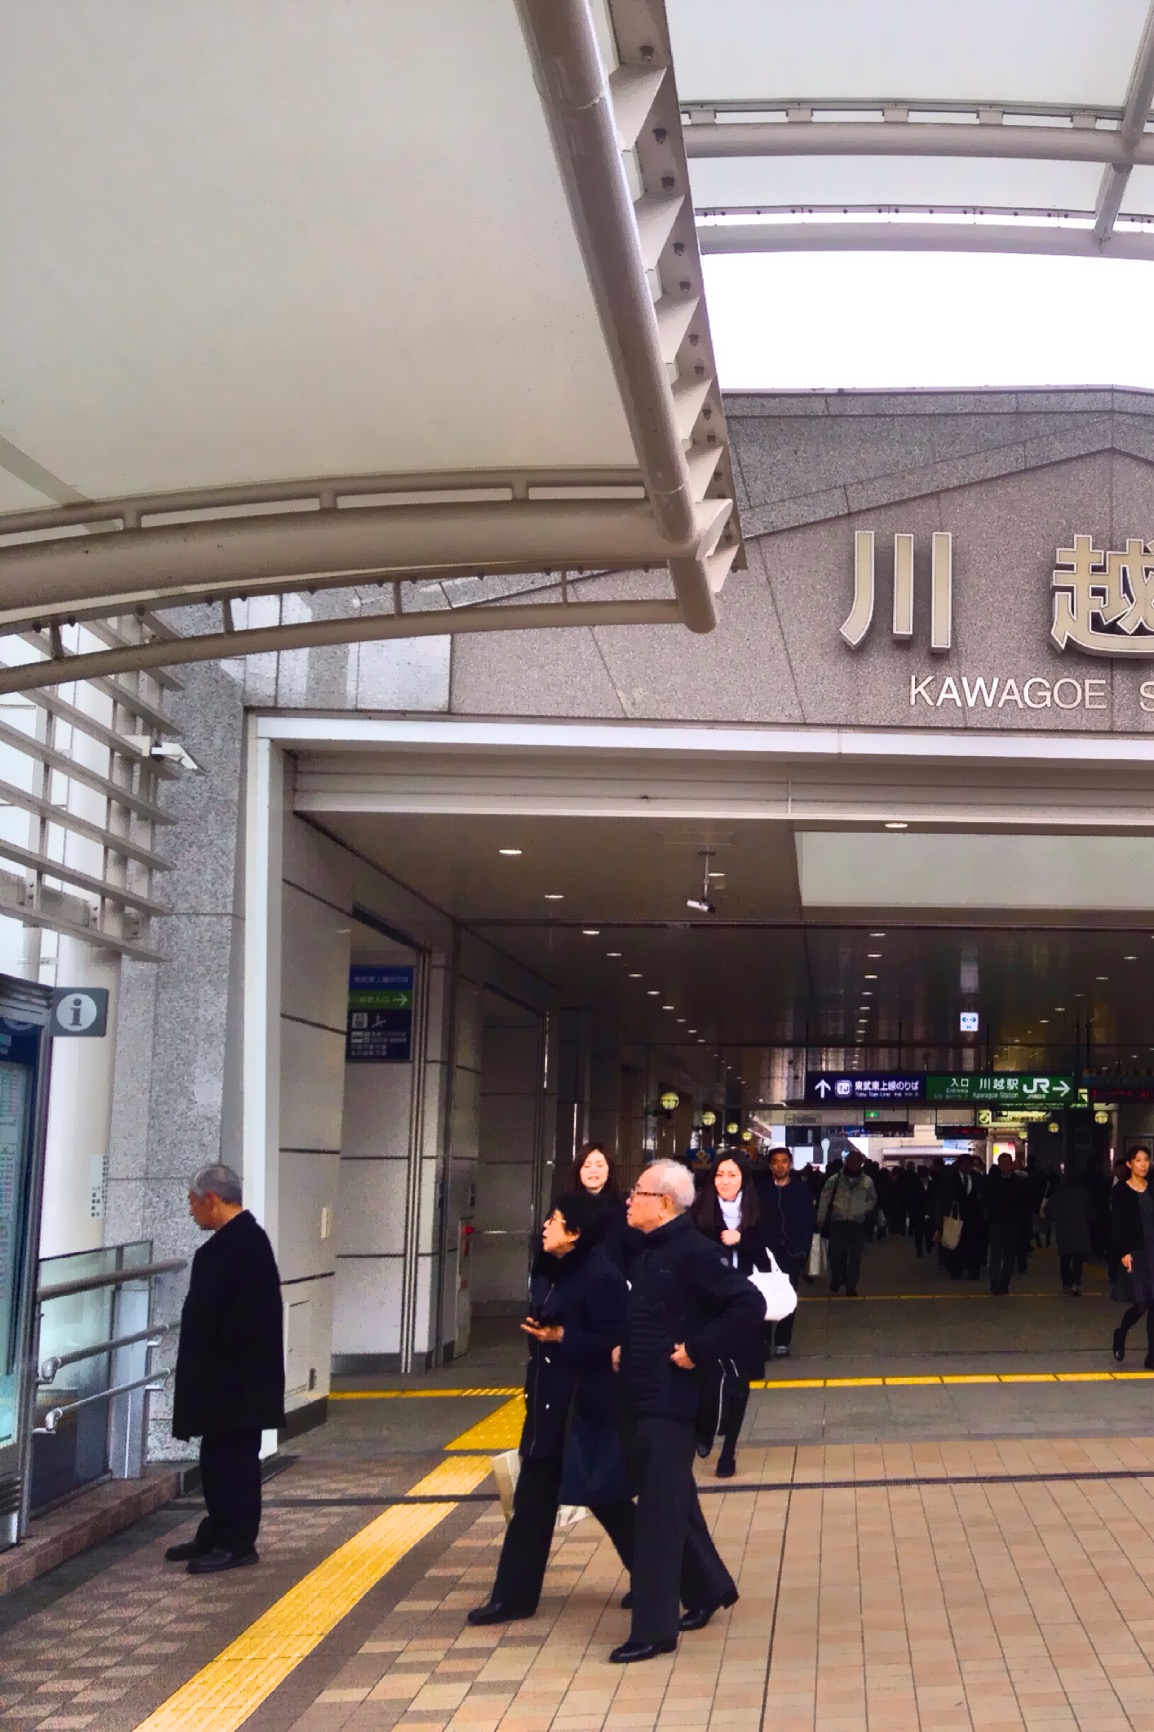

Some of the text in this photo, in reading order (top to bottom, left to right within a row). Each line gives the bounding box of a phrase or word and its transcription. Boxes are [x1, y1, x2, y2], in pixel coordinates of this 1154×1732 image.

[909, 675, 1108, 711] KAWAGOE
[950, 1078, 969, 1087] 入口
[979, 1078, 1019, 1090] 川越駅
[1022, 1077, 1051, 1094] JR
